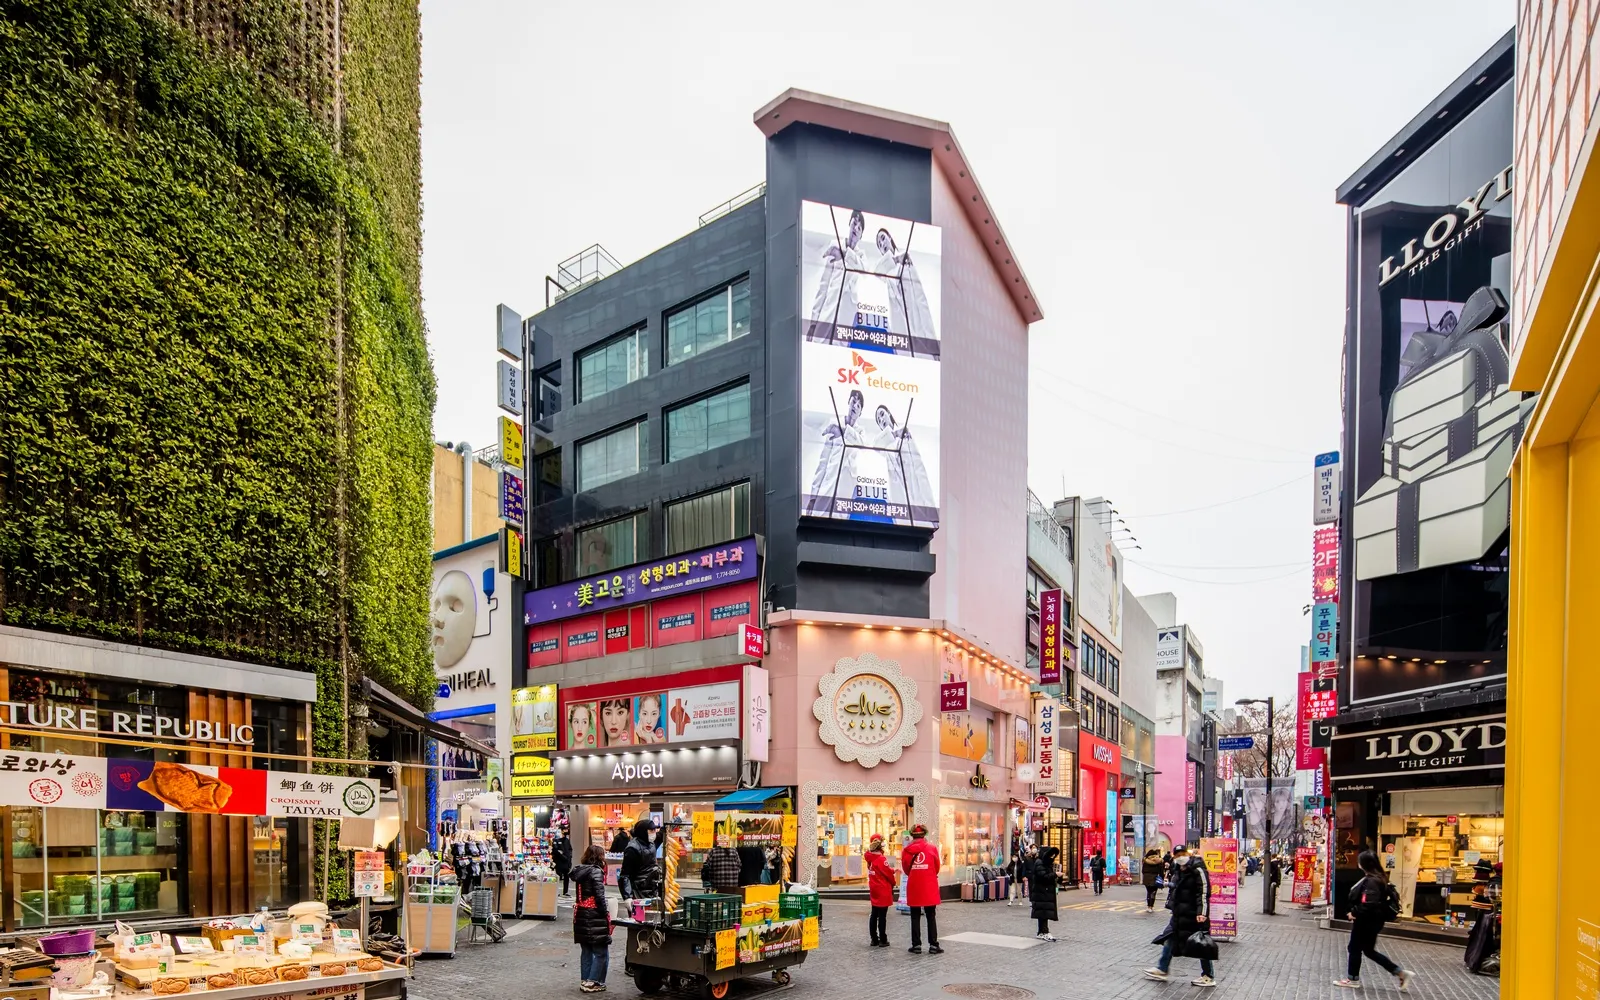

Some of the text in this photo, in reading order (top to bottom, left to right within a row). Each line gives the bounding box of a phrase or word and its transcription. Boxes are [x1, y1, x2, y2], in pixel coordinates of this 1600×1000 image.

[1408, 216, 1484, 277] THE GIFT
[856, 312, 888, 328] BLUE
[854, 331, 868, 340] S20+
[837, 367, 919, 394] SK telecom
[856, 485, 888, 500] BLUE
[1321, 468, 1332, 507] 백명기
[853, 503, 868, 511] S20+
[1315, 550, 1336, 567] 2F
[746, 631, 762, 643] キラ星
[1044, 594, 1056, 671] 노정식 성형외과
[1316, 607, 1333, 658] 푸른약국
[748, 645, 760, 653] かばん
[942, 688, 965, 697] キラ星
[0, 702, 255, 744] TURE REPUBLIC
[1365, 722, 1506, 760] LLOYD
[1093, 743, 1112, 764] MISSHA
[1303, 747, 1313, 765] Skin
[1399, 755, 1466, 768] THE GIFT
[516, 761, 549, 770] イチロカバン
[280, 778, 335, 794] 鲫鱼饼
[270, 797, 322, 805] CROISSANT
[1188, 790, 1194, 801] CO
[282, 805, 341, 816] TAIYAKI
